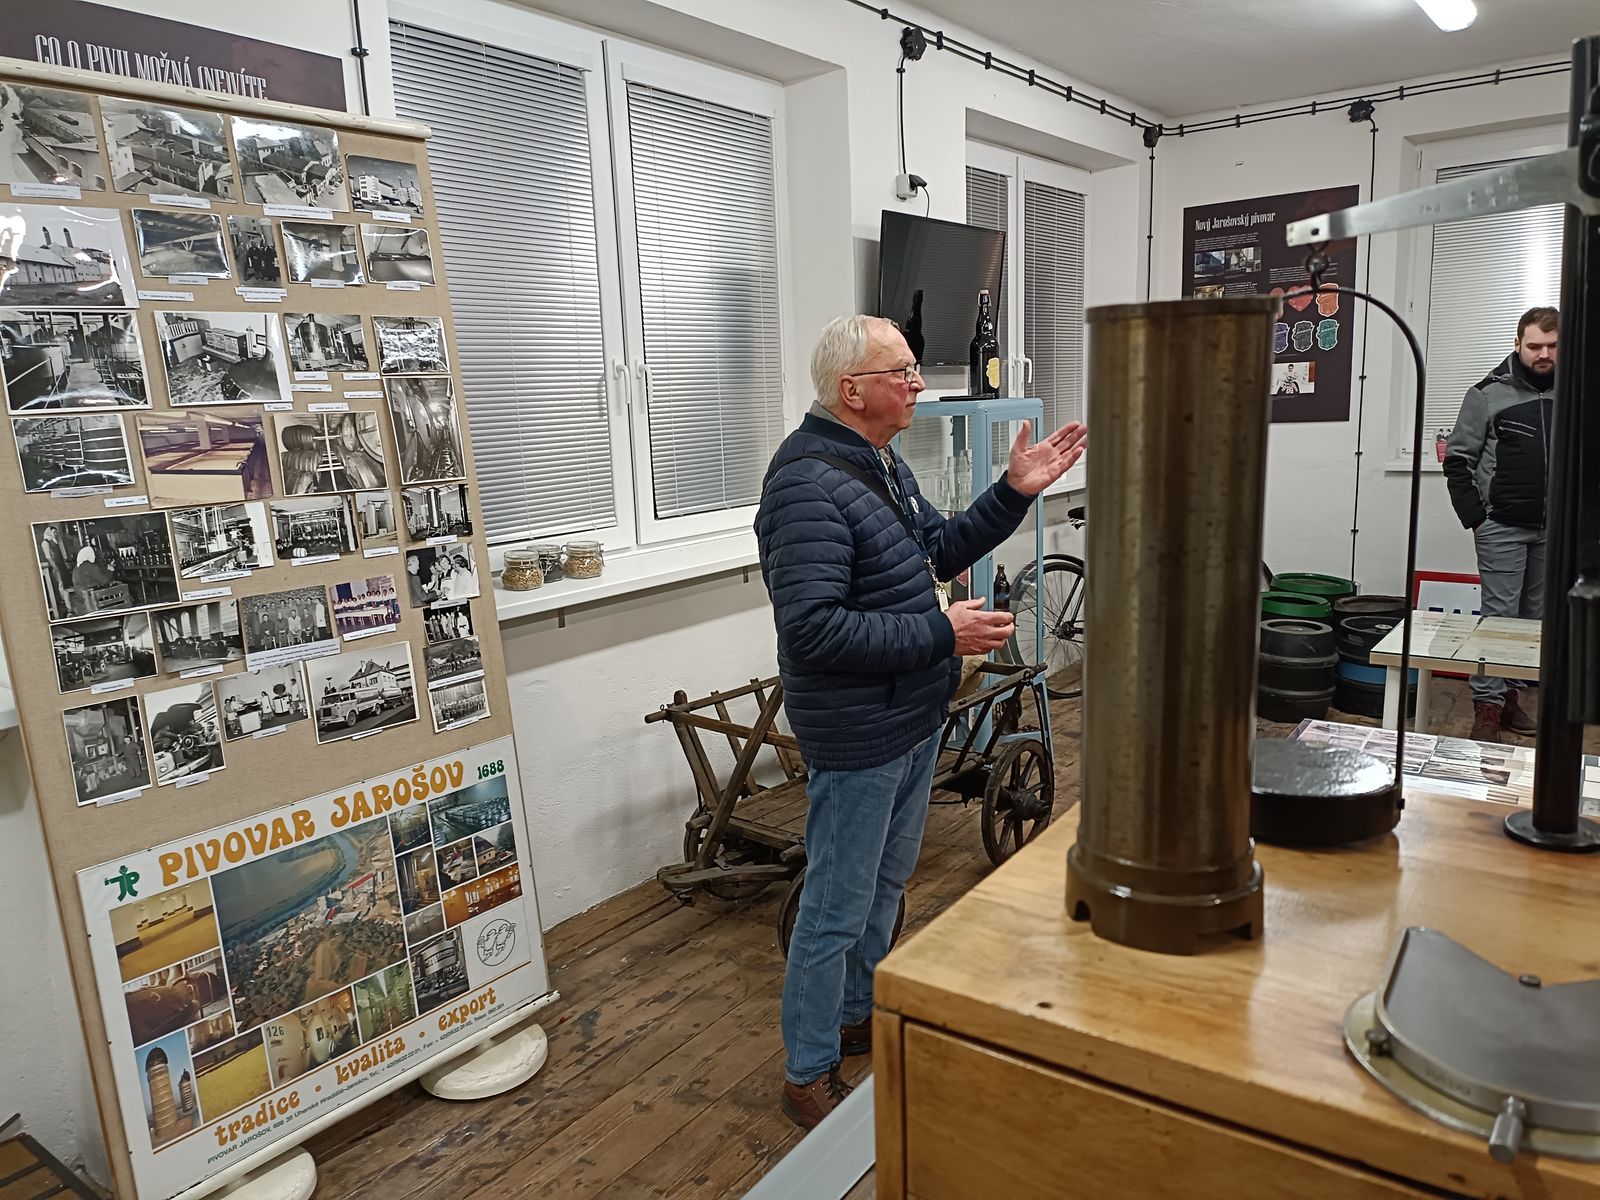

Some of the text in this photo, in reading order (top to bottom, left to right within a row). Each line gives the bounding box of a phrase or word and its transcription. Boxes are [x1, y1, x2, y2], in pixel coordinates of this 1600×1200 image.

[35, 34, 62, 65] CO
[67, 40, 82, 69] O
[134, 51, 194, 87] MOŽNÁ
[1194, 212, 1276, 232] Nový Jarošovský pivovar
[477, 759, 505, 780] 1688
[158, 760, 464, 887] PIVOVAR JAROŠOV
[266, 1026, 285, 1038] 126
[214, 987, 497, 1147] tradice kvalita export
[207, 1144, 238, 1164] PIVOVAR
